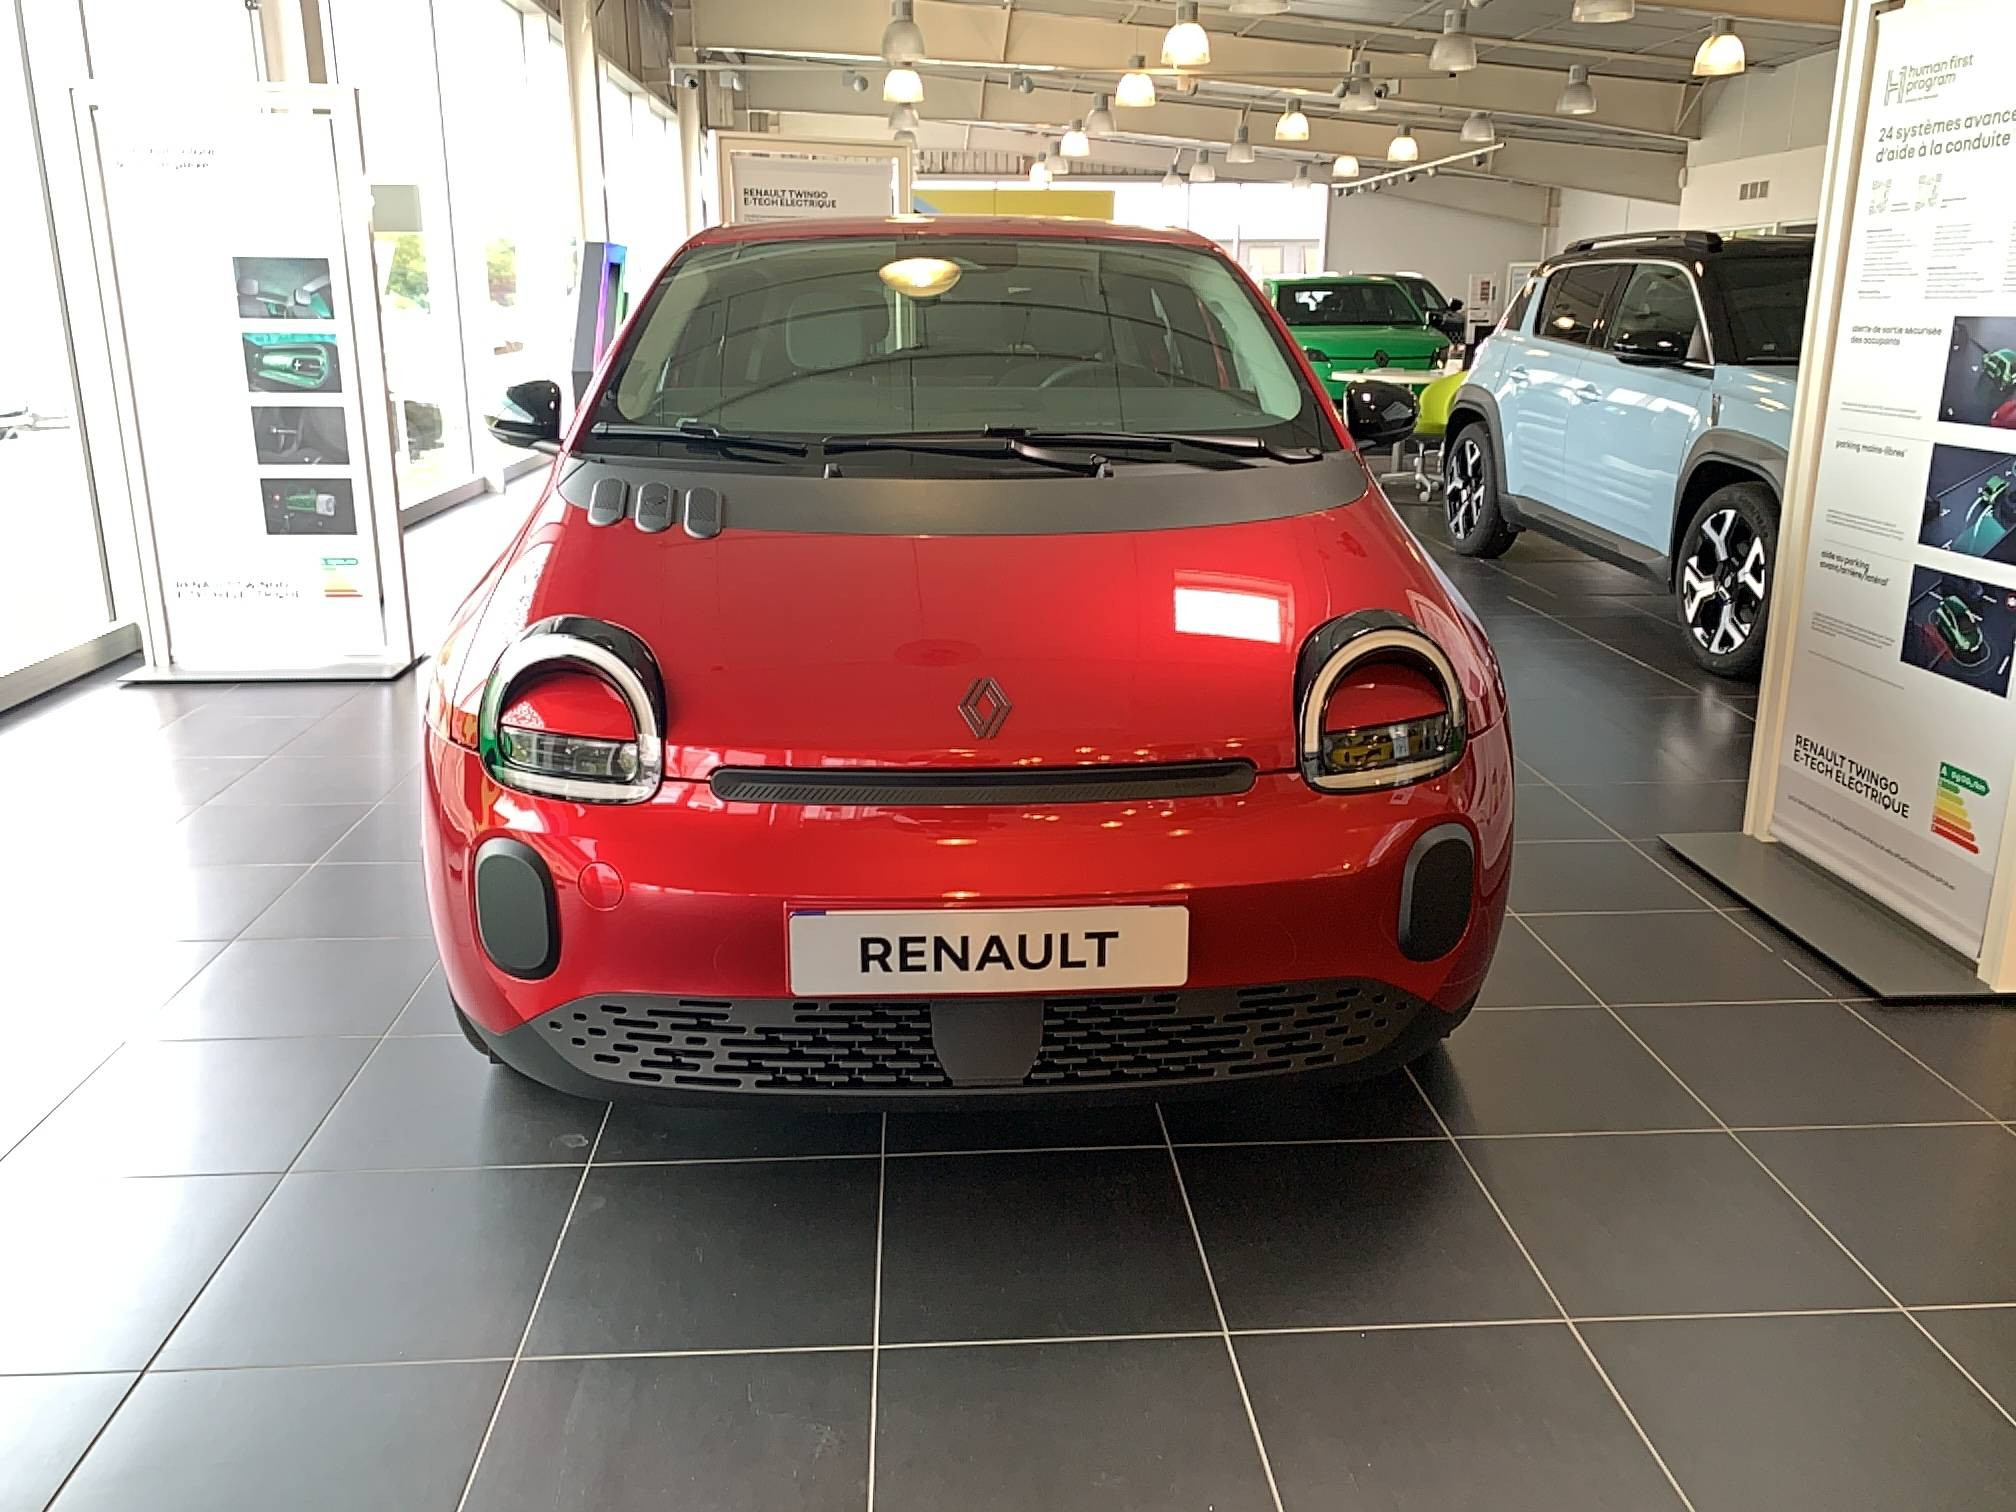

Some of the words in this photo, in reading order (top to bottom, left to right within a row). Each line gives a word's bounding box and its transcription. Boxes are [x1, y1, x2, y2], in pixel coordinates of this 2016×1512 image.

[1909, 61, 1948, 78] human
[1949, 54, 1974, 70] first
[1906, 73, 1956, 95] program
[1878, 126, 1893, 142] 24
[1895, 118, 1962, 143] systèmes
[1875, 143, 1916, 163] d'aide
[1918, 141, 1927, 157] à
[1929, 139, 1943, 156] la
[1945, 130, 2011, 154] conduite
[743, 188, 786, 198] RENAULT
[788, 189, 829, 199] TWINGO
[743, 197, 779, 207] E-TECH
[780, 199, 837, 209] ELECTRIQUE
[1835, 440, 1861, 453] parking
[1844, 557, 1869, 572] parking
[1795, 734, 1846, 769] RENAULT
[1848, 759, 1899, 796] TWINGO
[1793, 748, 1834, 779] E-TECH
[1834, 769, 1910, 818] ELECTRIQUE
[860, 931, 1119, 974] RENAULT
